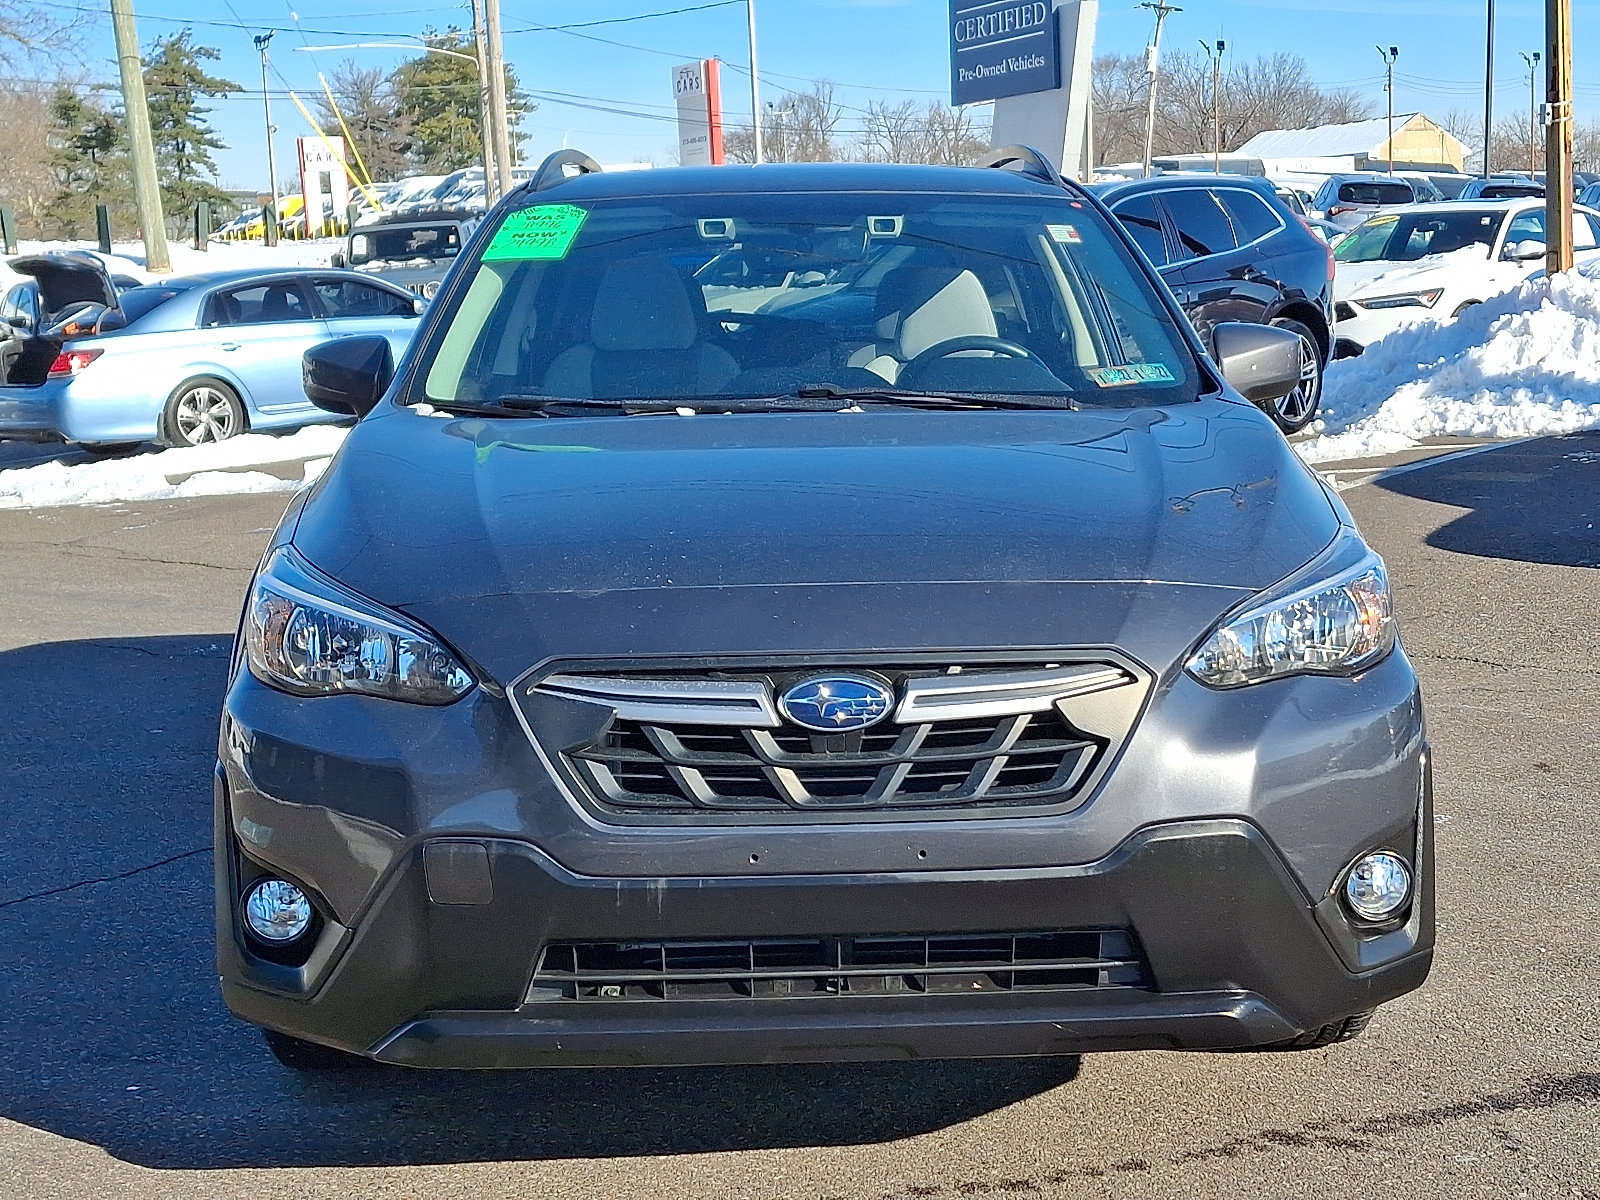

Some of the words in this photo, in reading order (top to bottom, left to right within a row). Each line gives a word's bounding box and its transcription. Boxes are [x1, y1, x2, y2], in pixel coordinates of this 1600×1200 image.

[954, 2, 1046, 42] CERTIFIED
[958, 59, 1006, 82] Pre-Owned
[1007, 54, 1045, 72] Vehicles
[676, 76, 700, 93] CARS
[306, 152, 341, 162] CAR
